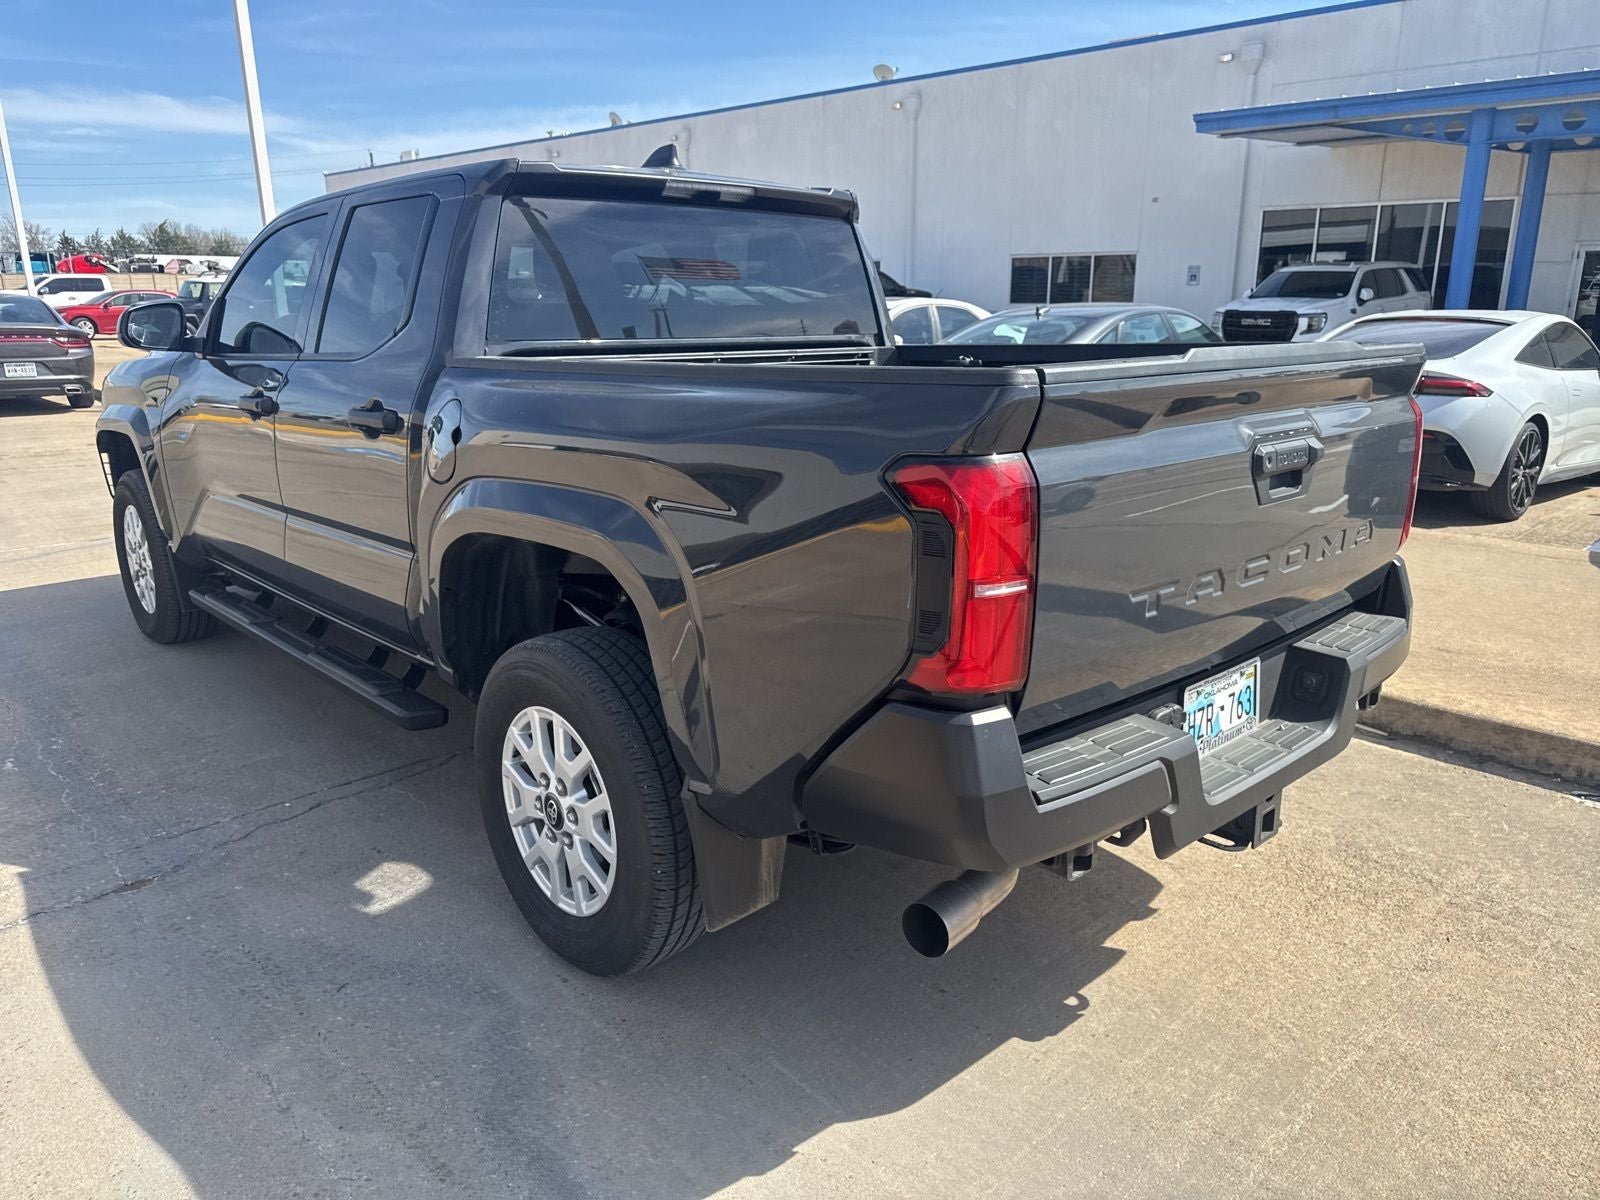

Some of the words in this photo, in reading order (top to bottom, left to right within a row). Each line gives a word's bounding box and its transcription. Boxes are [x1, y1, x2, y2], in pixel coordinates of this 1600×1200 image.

[1241, 318, 1271, 326] GMC
[1129, 519, 1374, 618] TACOMA
[1203, 679, 1238, 700] OKLAHOMA
